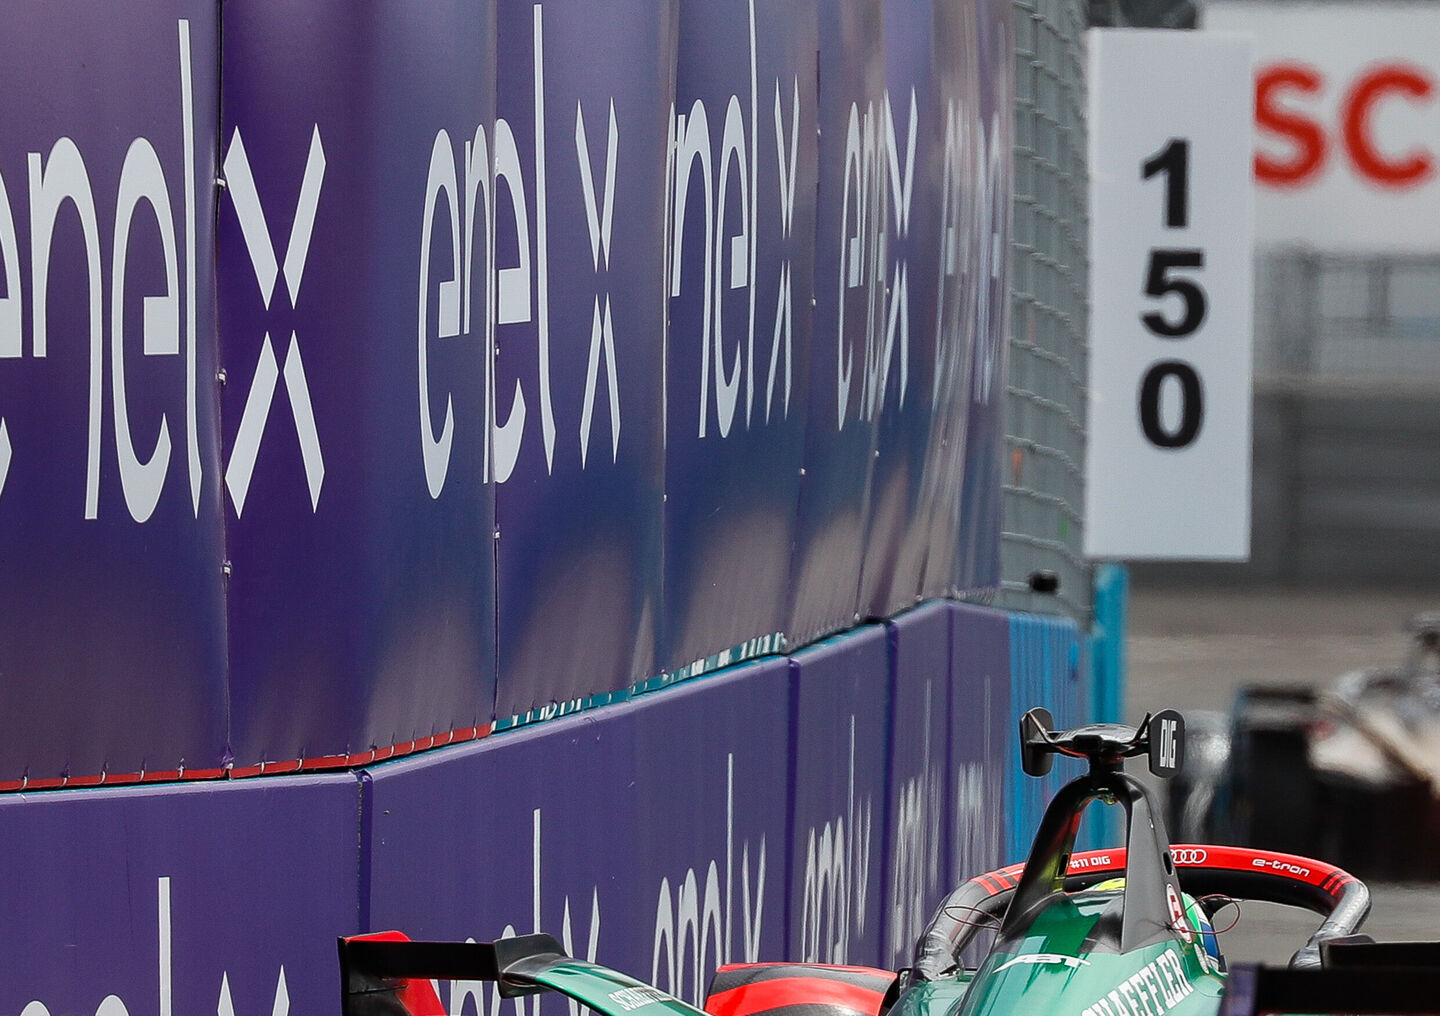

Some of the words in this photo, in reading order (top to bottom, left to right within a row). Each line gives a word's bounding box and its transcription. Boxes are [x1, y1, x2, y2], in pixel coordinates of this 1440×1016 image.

[418, 3, 556, 499] enel
[1137, 137, 1209, 451] 150
[1159, 718, 1178, 769] DIG
[1090, 855, 1111, 867] DIG
[1251, 857, 1311, 878] e-tron
